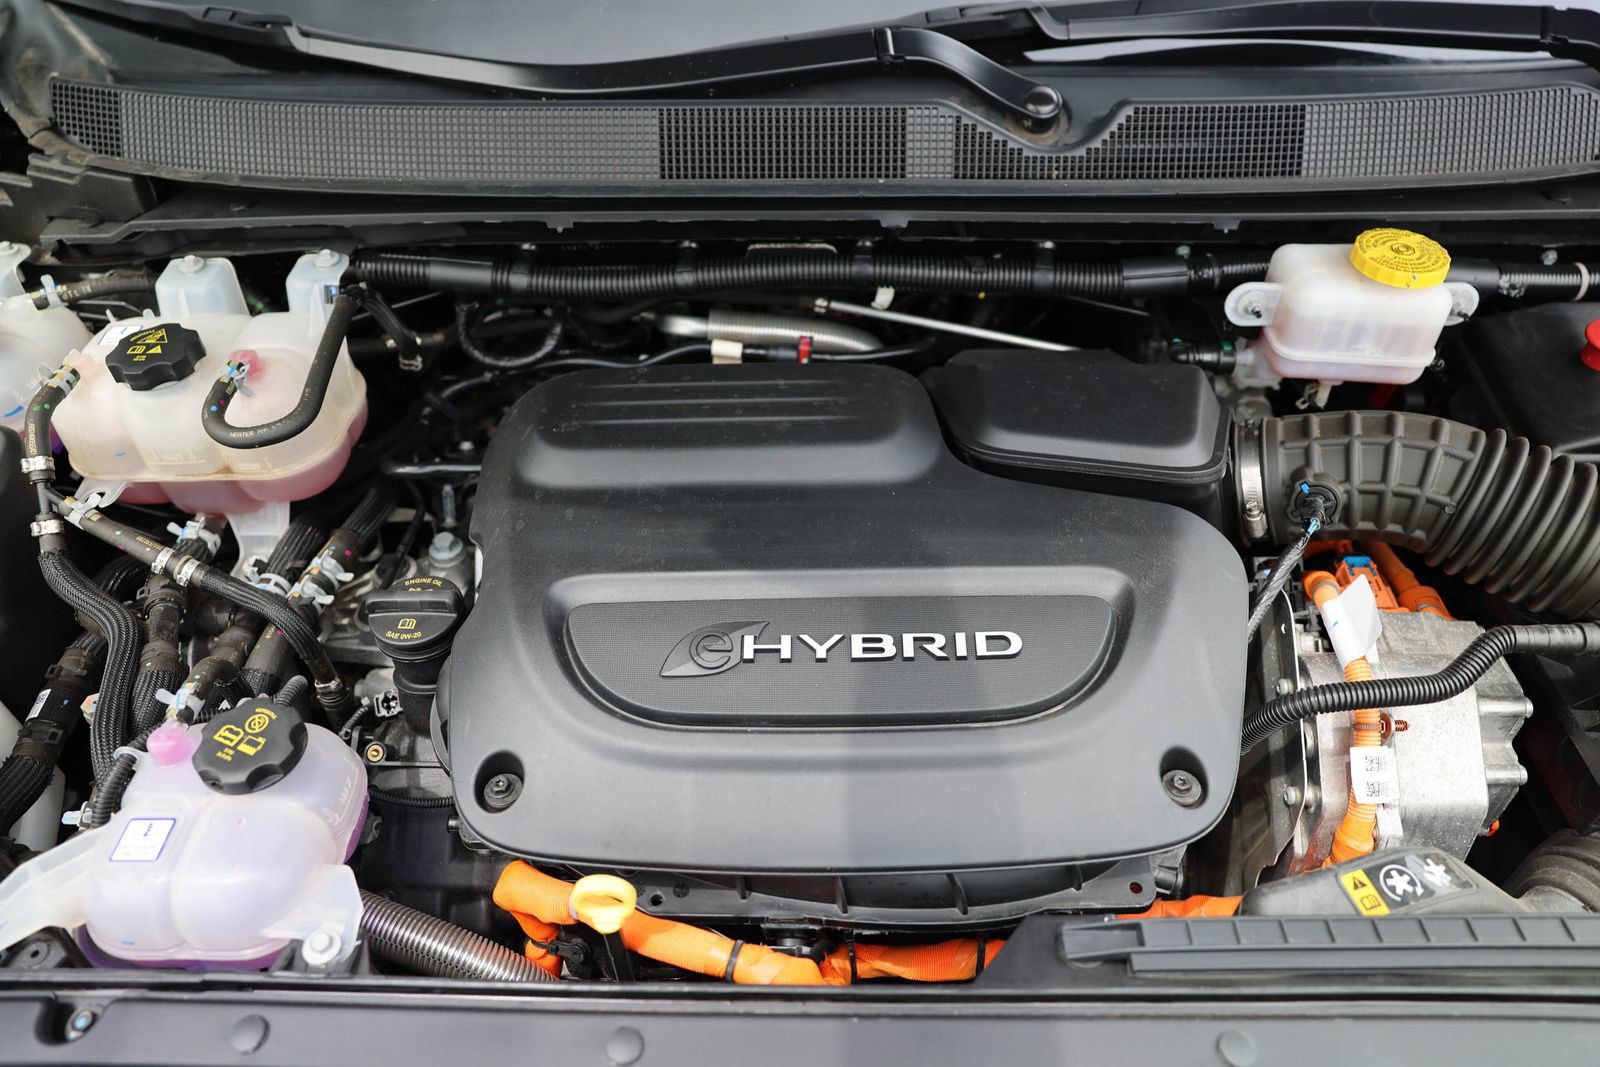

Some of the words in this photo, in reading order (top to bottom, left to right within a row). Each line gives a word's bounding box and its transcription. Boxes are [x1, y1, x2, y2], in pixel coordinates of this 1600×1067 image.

[229, 430, 254, 438] HEATER
[404, 578, 432, 586] ENGINE
[432, 579, 443, 587] OIL
[385, 631, 400, 639] SAE
[400, 631, 422, 640] 0W-20
